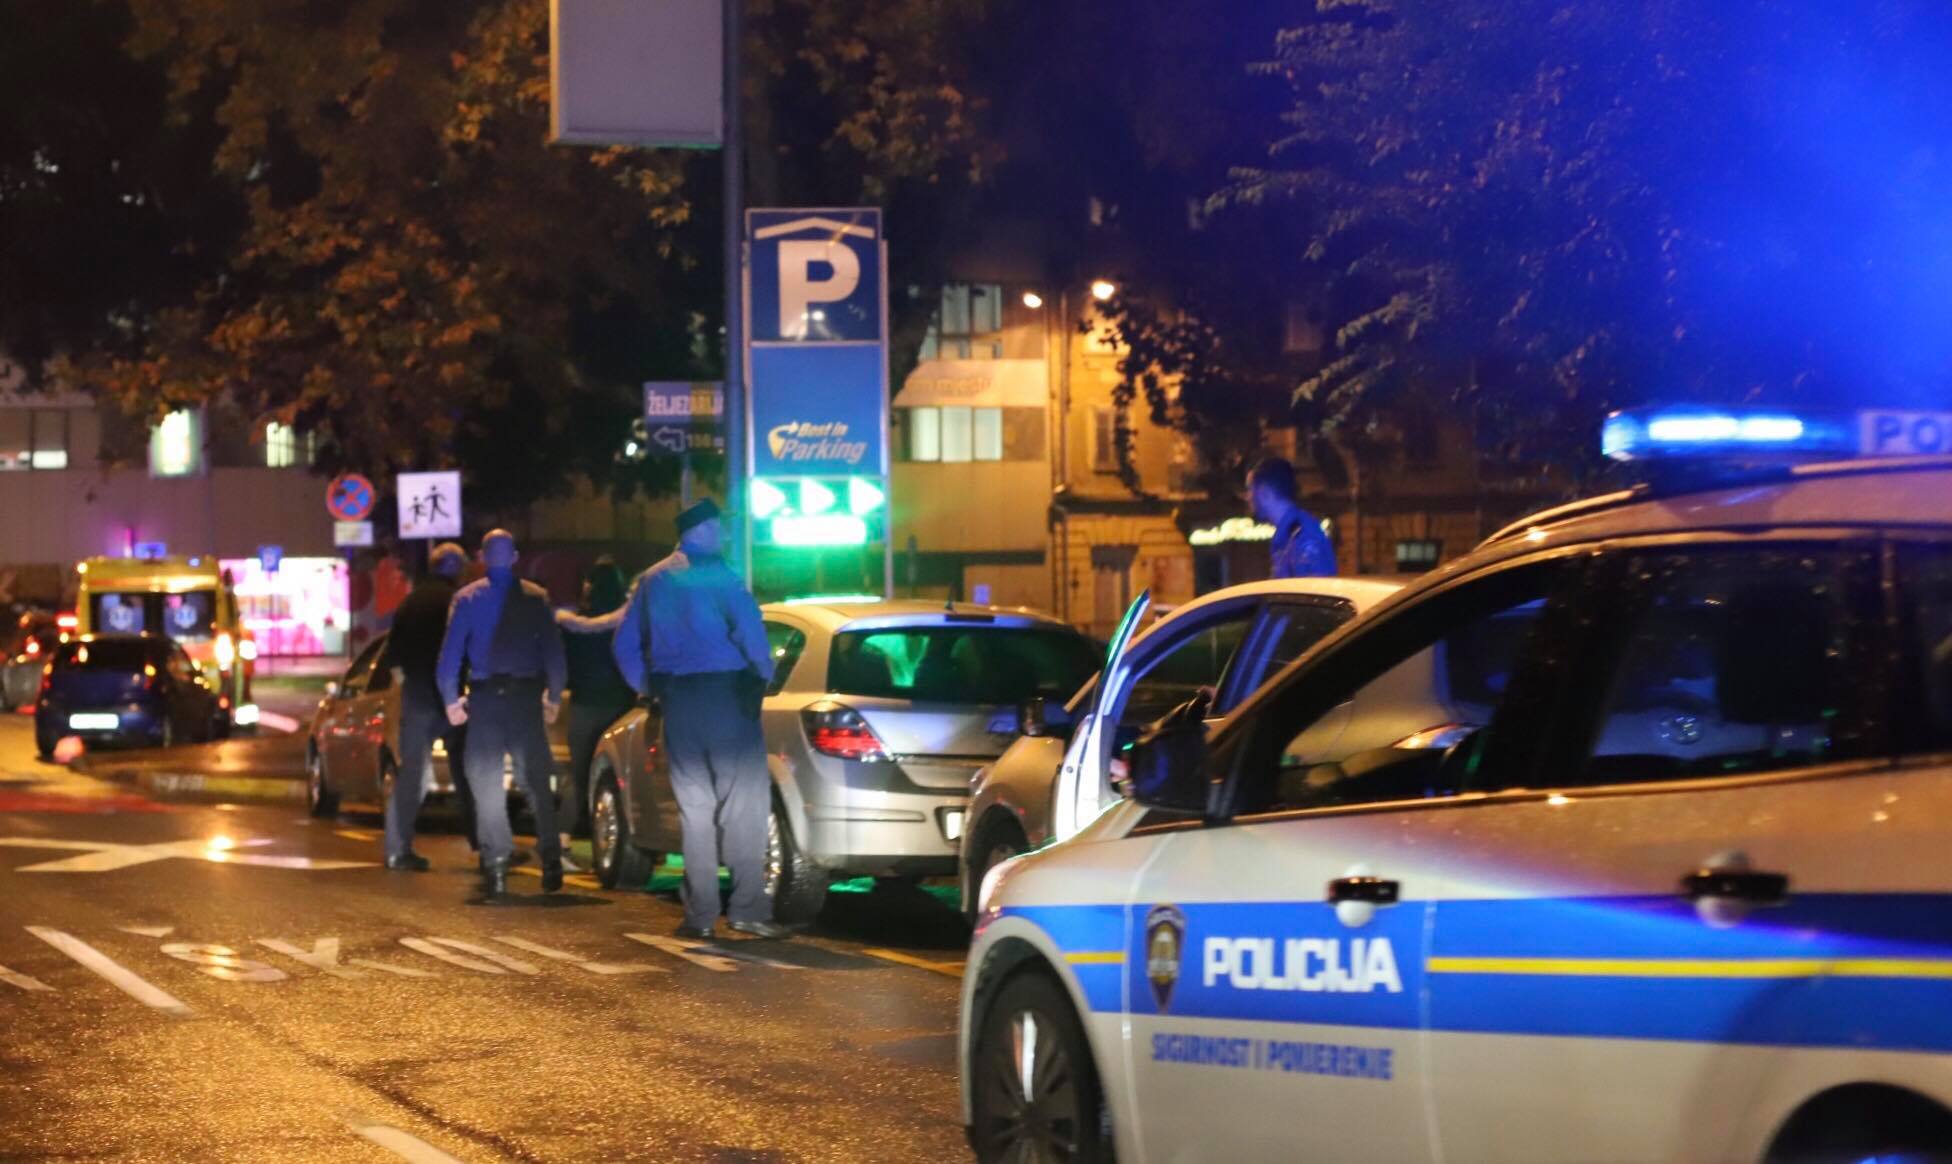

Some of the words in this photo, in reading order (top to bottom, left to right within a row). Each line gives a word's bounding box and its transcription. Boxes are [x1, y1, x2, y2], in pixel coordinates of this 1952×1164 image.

[779, 240, 860, 337] P
[780, 438, 867, 464] Parking
[798, 422, 833, 437] Best
[1203, 936, 1403, 993] POLICIJA
[1152, 1033, 1250, 1068] SIGURNOST
[1253, 1039, 1261, 1069] I
[1265, 1040, 1393, 1080] POVJERENJE
